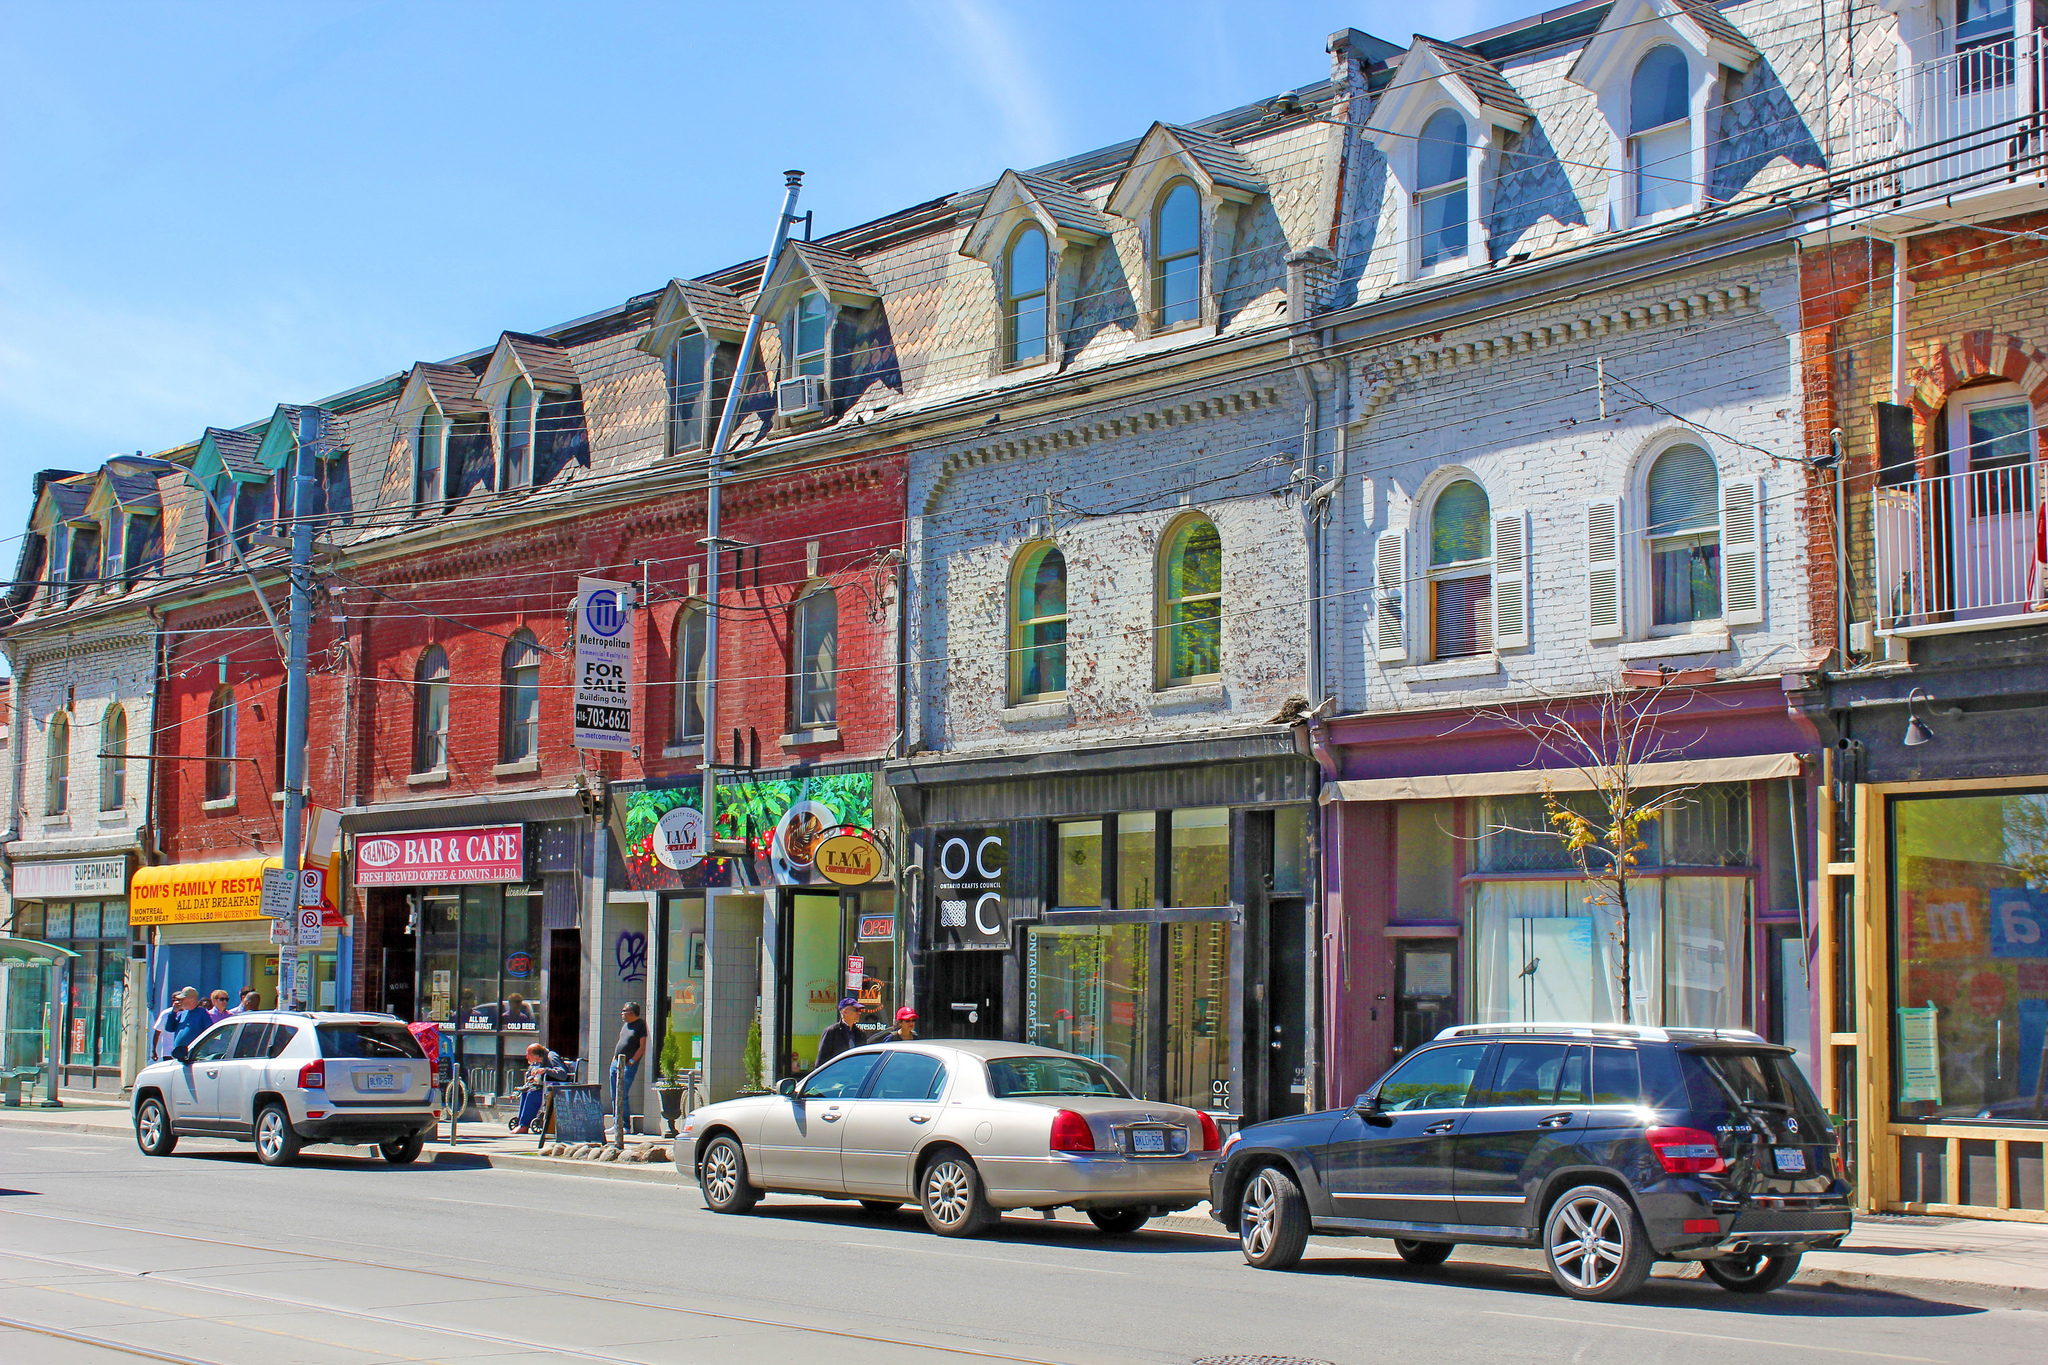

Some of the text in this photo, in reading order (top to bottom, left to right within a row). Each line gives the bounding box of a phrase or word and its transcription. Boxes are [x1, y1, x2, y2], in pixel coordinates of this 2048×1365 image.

[580, 634, 631, 649] Metropolitan
[606, 651, 621, 660] Realty
[586, 662, 623, 679] FOR
[583, 677, 627, 694] SALE
[579, 692, 628, 706] Building Only
[363, 831, 518, 864] FRANKIE'S BAR & CAFÉ
[661, 852, 676, 865] MICRO
[826, 850, 864, 868] T.A.N.
[14, 867, 41, 893] KAM
[75, 862, 123, 881] SUPERMARKET
[359, 871, 384, 883] FRESH
[385, 870, 418, 882] BREWED
[420, 870, 448, 881] COFFEE
[450, 870, 457, 880] &
[826, 866, 870, 875] Coffee
[134, 884, 169, 899] TOM'S
[173, 880, 217, 897] FAMILY
[221, 877, 262, 894] RESTA
[505, 884, 530, 897] licensed
[177, 898, 192, 910] ALL
[193, 898, 211, 909] DAY
[212, 895, 260, 908] BREAKFAST
[134, 907, 163, 915] MONTREAL
[223, 910, 244, 919] QUEEN
[244, 909, 252, 917] ST
[252, 909, 258, 917] W
[975, 891, 1001, 935] C
[131, 915, 154, 923] SMOKED
[861, 919, 893, 936] OPEN
[0, 961, 25, 969] ington
[507, 957, 533, 971] OPEN
[850, 960, 862, 968] OPEN
[1029, 932, 1037, 988] ONTARIO
[1028, 990, 1037, 1038] CRAFTS
[464, 1022, 492, 1030] BREAKFAST
[507, 1022, 536, 1030] COLD BEER
[855, 1022, 887, 1031] presso Bar
[560, 1089, 592, 1103] TAN
